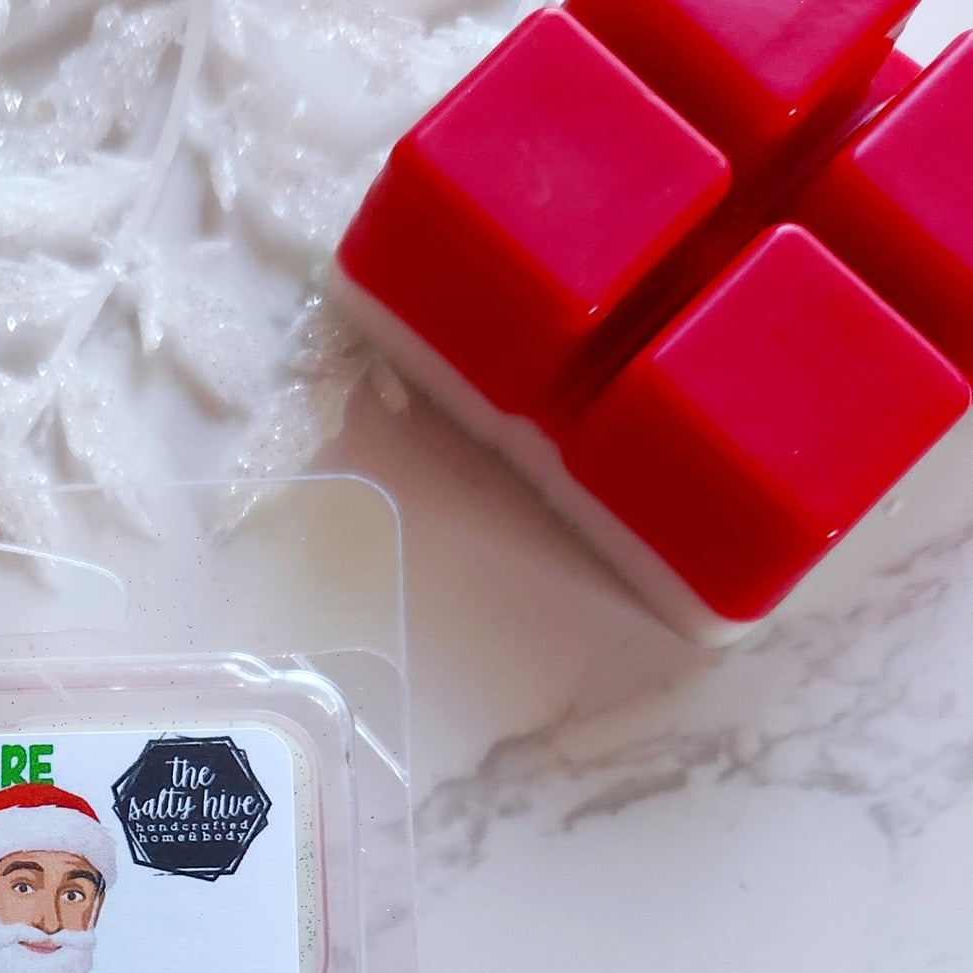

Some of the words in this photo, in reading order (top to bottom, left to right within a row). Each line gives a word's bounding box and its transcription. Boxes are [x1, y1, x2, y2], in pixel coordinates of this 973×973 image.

[165, 756, 217, 790] the
[128, 788, 196, 820] salty
[203, 789, 261, 820] hive
[135, 821, 249, 832] handcrafted
